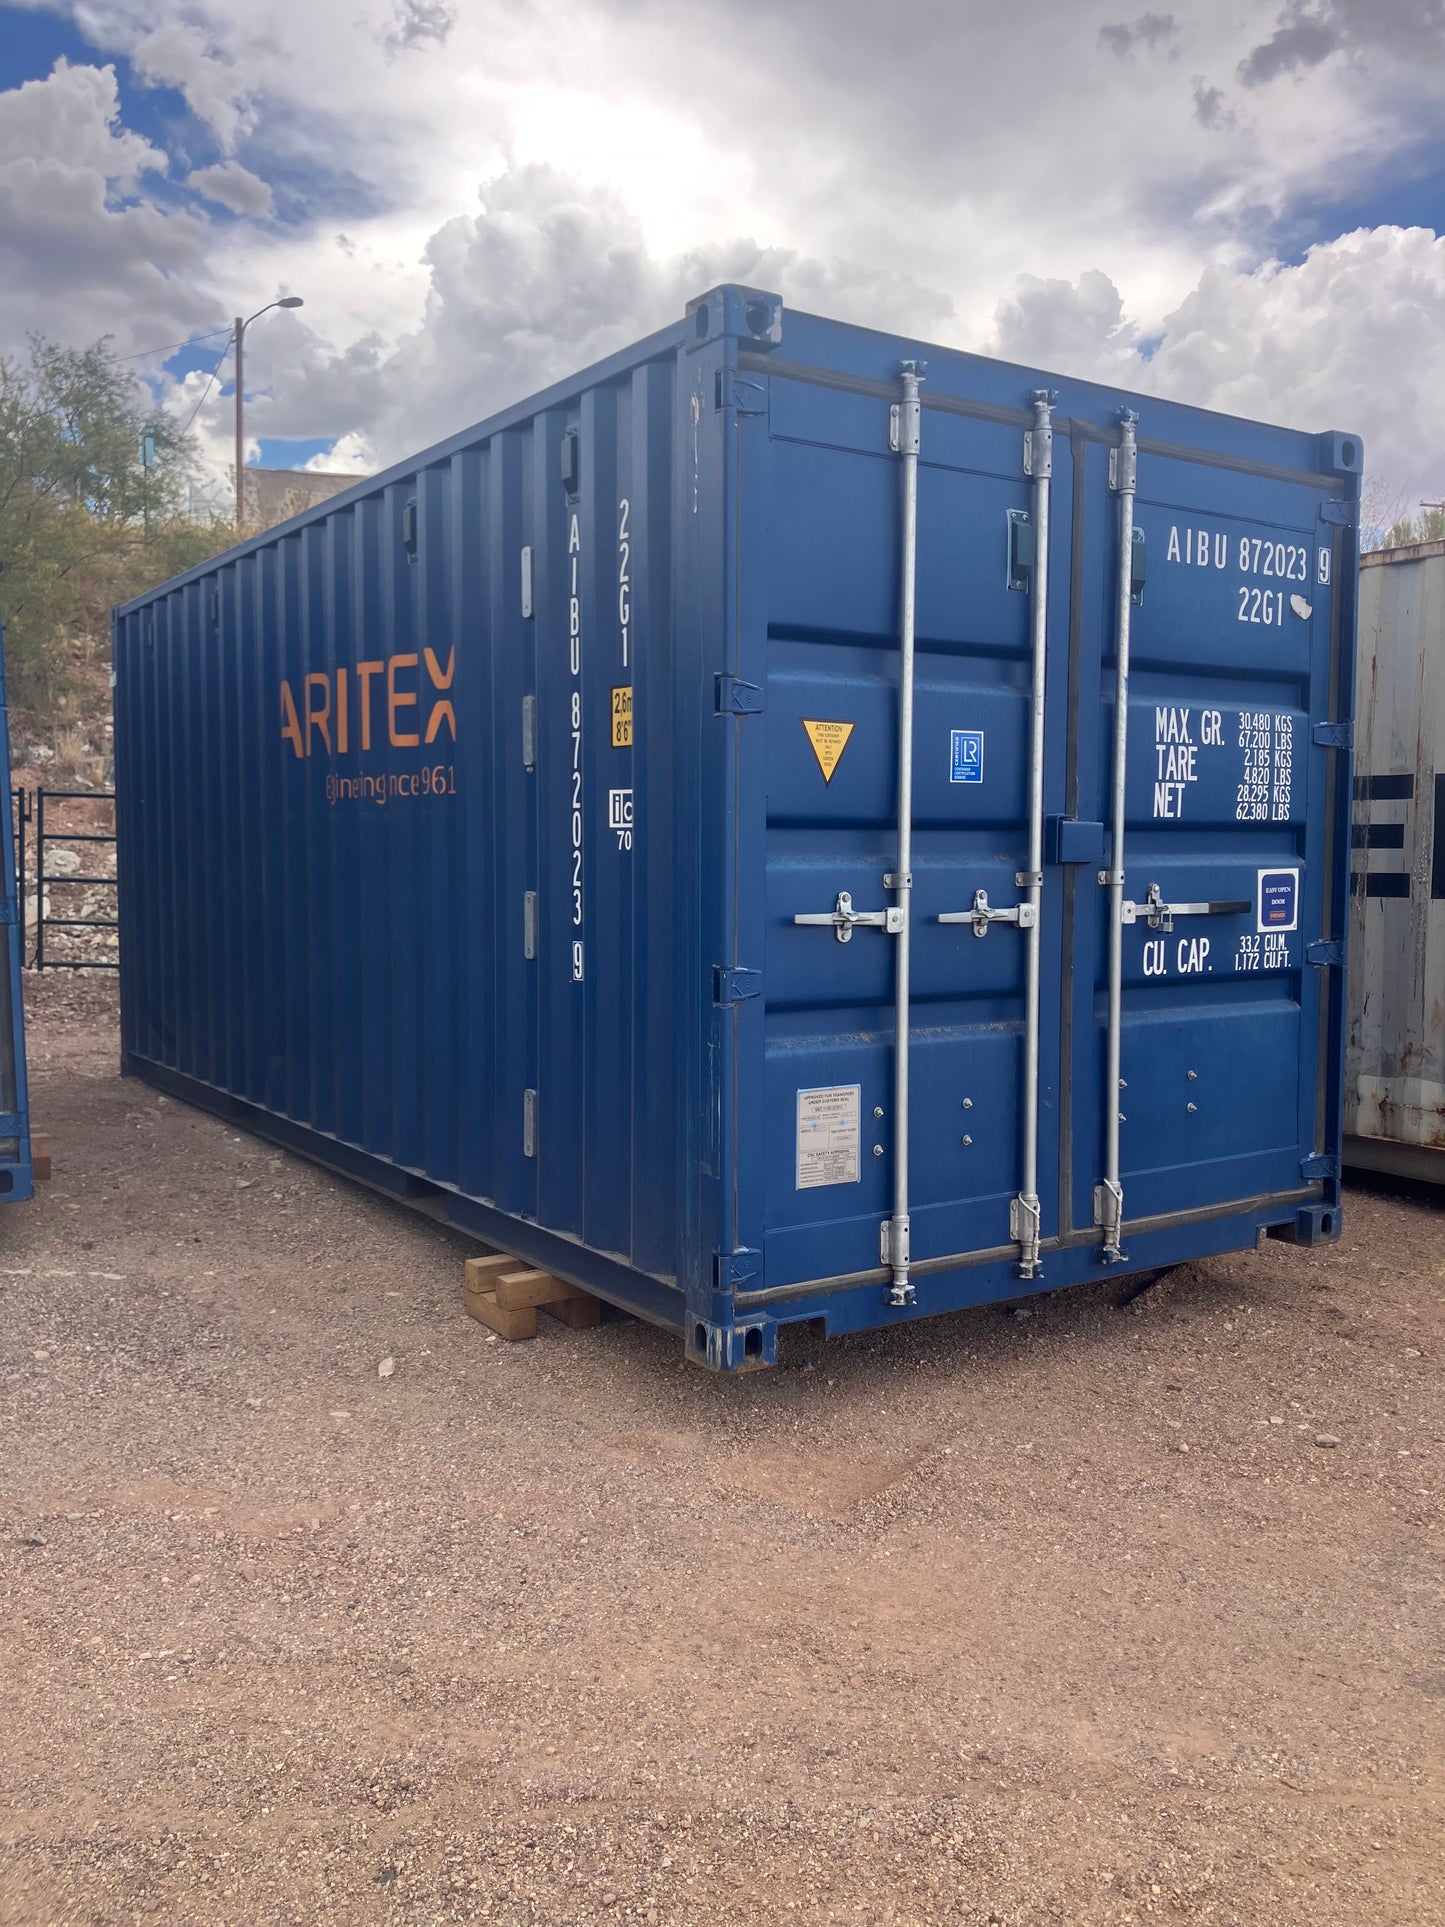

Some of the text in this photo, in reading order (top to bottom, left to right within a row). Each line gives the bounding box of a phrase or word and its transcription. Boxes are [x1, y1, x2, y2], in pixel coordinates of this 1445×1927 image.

[1167, 526, 1330, 583] AIBU 872023 9
[619, 499, 630, 667] 22G1
[1238, 586, 1283, 626] 22G1
[280, 644, 456, 758] ARITEX
[816, 724, 843, 732] ATTENTION
[1156, 707, 1225, 745] MAX. GR.
[1275, 715, 1292, 732] KGS
[569, 514, 582, 979] AIBU 872023 9
[964, 740, 977, 763] LR
[1275, 733, 1292, 750] LBS
[1156, 745, 1198, 781] TARE
[1274, 751, 1292, 767] KGS
[1274, 768, 1291, 785] LBS
[1153, 782, 1185, 818] NET
[1273, 786, 1291, 803] KGS
[1272, 804, 1290, 821] LBS
[616, 830, 632, 850] 70
[1240, 935, 1260, 953] 33.2
[1143, 938, 1213, 976] CU. CAP.
